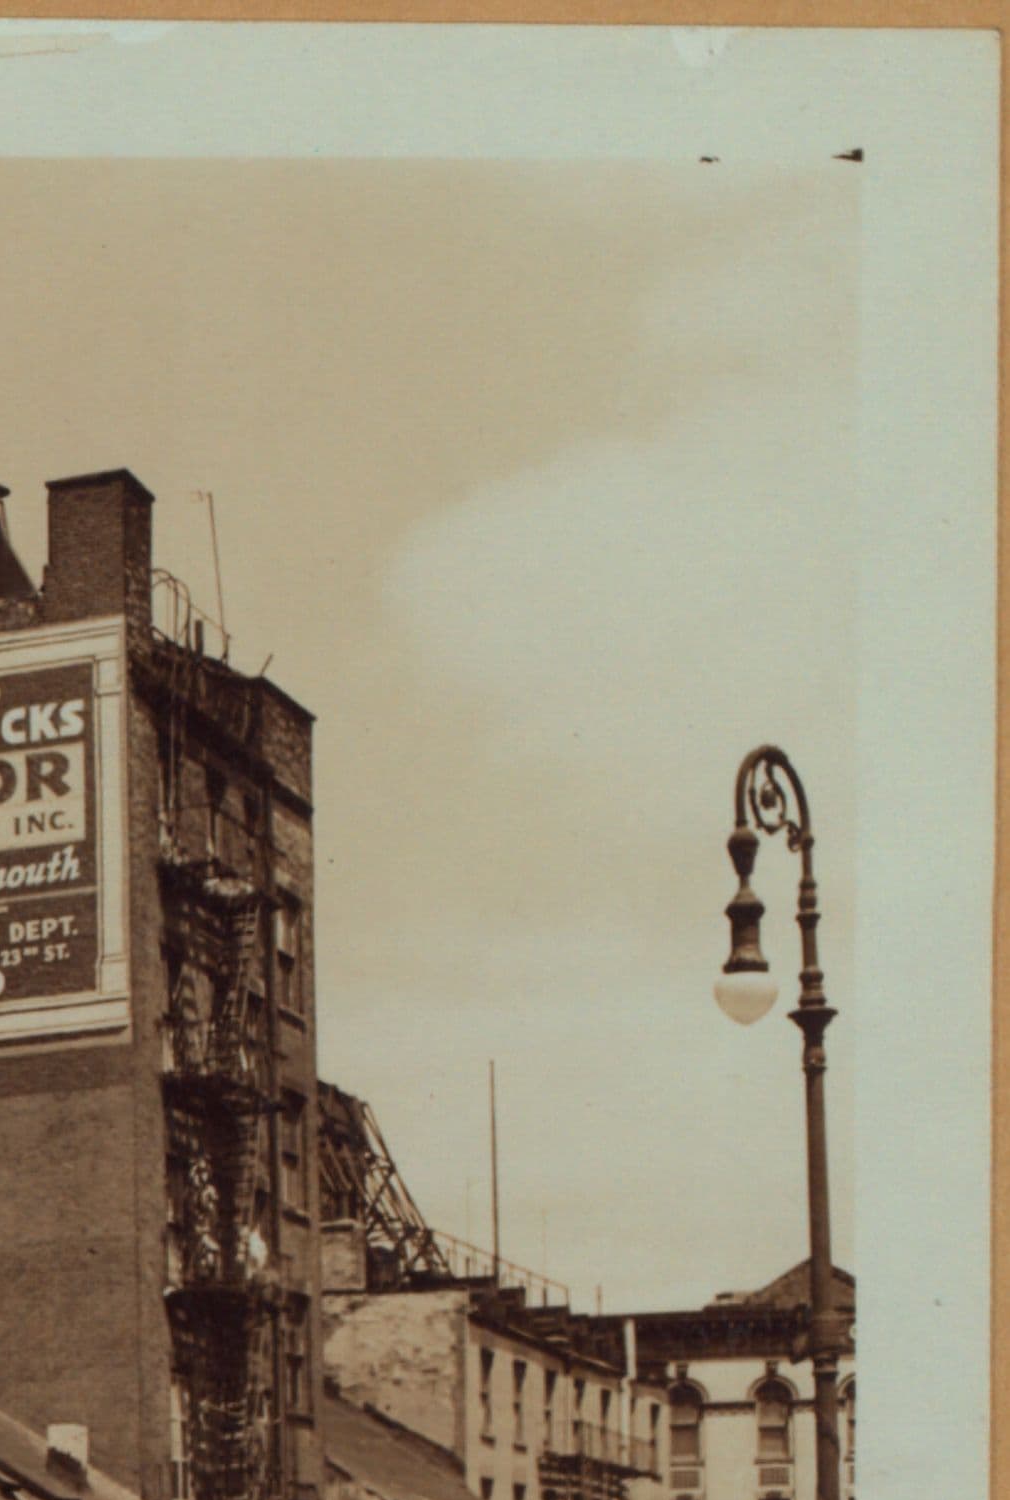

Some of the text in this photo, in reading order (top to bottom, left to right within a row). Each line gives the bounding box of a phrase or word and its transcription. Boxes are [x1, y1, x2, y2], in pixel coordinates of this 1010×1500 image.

[13, 811, 74, 837] INC.
[9, 914, 79, 944] DEPT.
[43, 943, 71, 963] ST.
